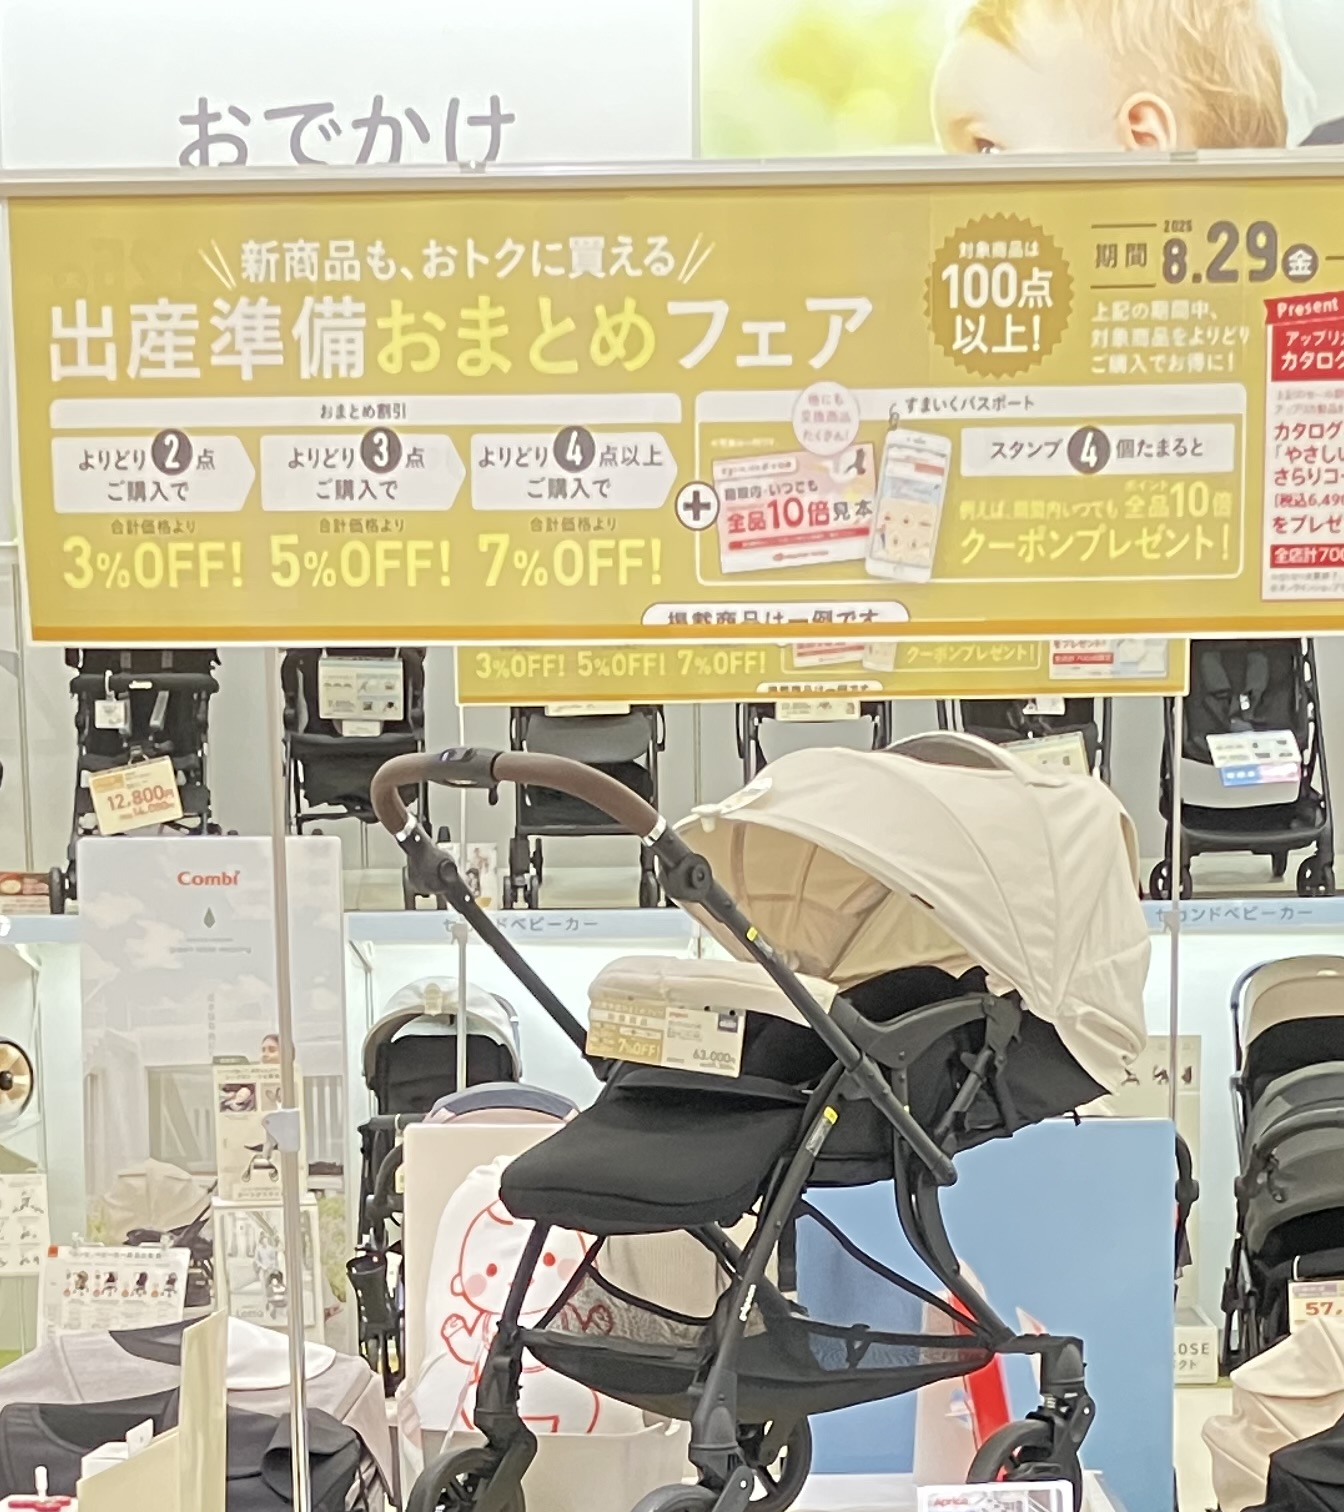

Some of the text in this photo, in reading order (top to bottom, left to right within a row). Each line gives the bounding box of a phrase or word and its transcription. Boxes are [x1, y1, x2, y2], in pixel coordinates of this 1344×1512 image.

[178, 94, 516, 167] おでかけ
[240, 234, 676, 284] 新商品も、おトクに買える
[958, 239, 1040, 262] 対象商品は
[1095, 242, 1148, 270] 期間
[941, 263, 1055, 311] 100点
[1091, 300, 1218, 323] 上記の期間中、
[1276, 298, 1339, 319] Present
[49, 294, 874, 383] 出産準備おまとめフェア
[953, 313, 1042, 355] 以上!
[1091, 327, 1250, 349] 対象商品をよりどり
[320, 401, 407, 422] おまとめ割引
[107, 477, 190, 503] ご購入で
[315, 477, 398, 503] ご購入で
[525, 475, 612, 501] ご購入で
[110, 517, 197, 536] 合計価格より
[319, 516, 406, 535] 合計価格より
[529, 515, 618, 534] 合計価格より
[960, 525, 1230, 565] クーポンプレゼント!
[62, 535, 244, 591] 3%OFF!
[270, 533, 453, 591] 5%OFF!
[477, 532, 662, 589] 7%OFF!
[177, 869, 240, 887] Combi
[1175, 1343, 1210, 1356] OSE
